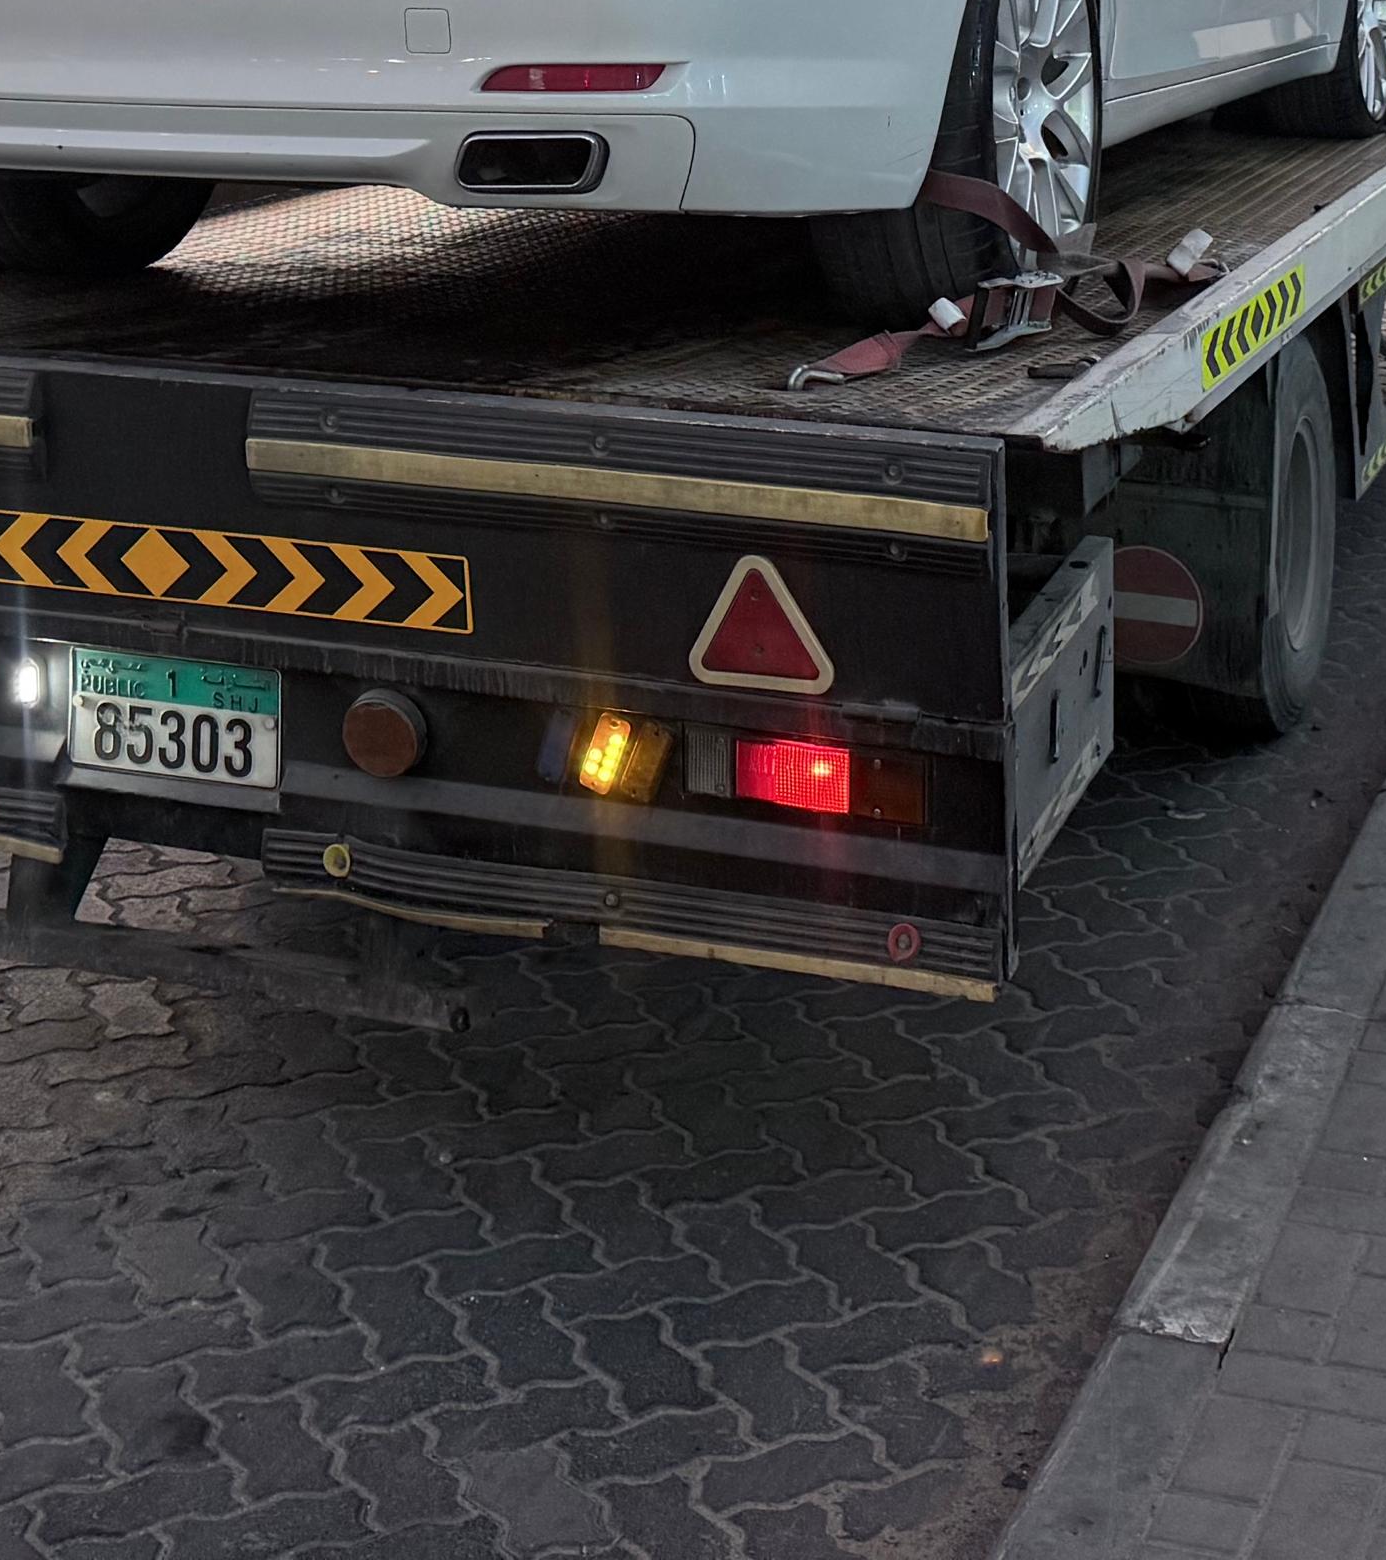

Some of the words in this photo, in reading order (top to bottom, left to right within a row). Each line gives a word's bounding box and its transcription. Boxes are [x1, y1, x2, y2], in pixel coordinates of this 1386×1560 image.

[81, 675, 146, 699] PUBLIC
[166, 669, 177, 698] 1
[94, 701, 253, 778] 85303
